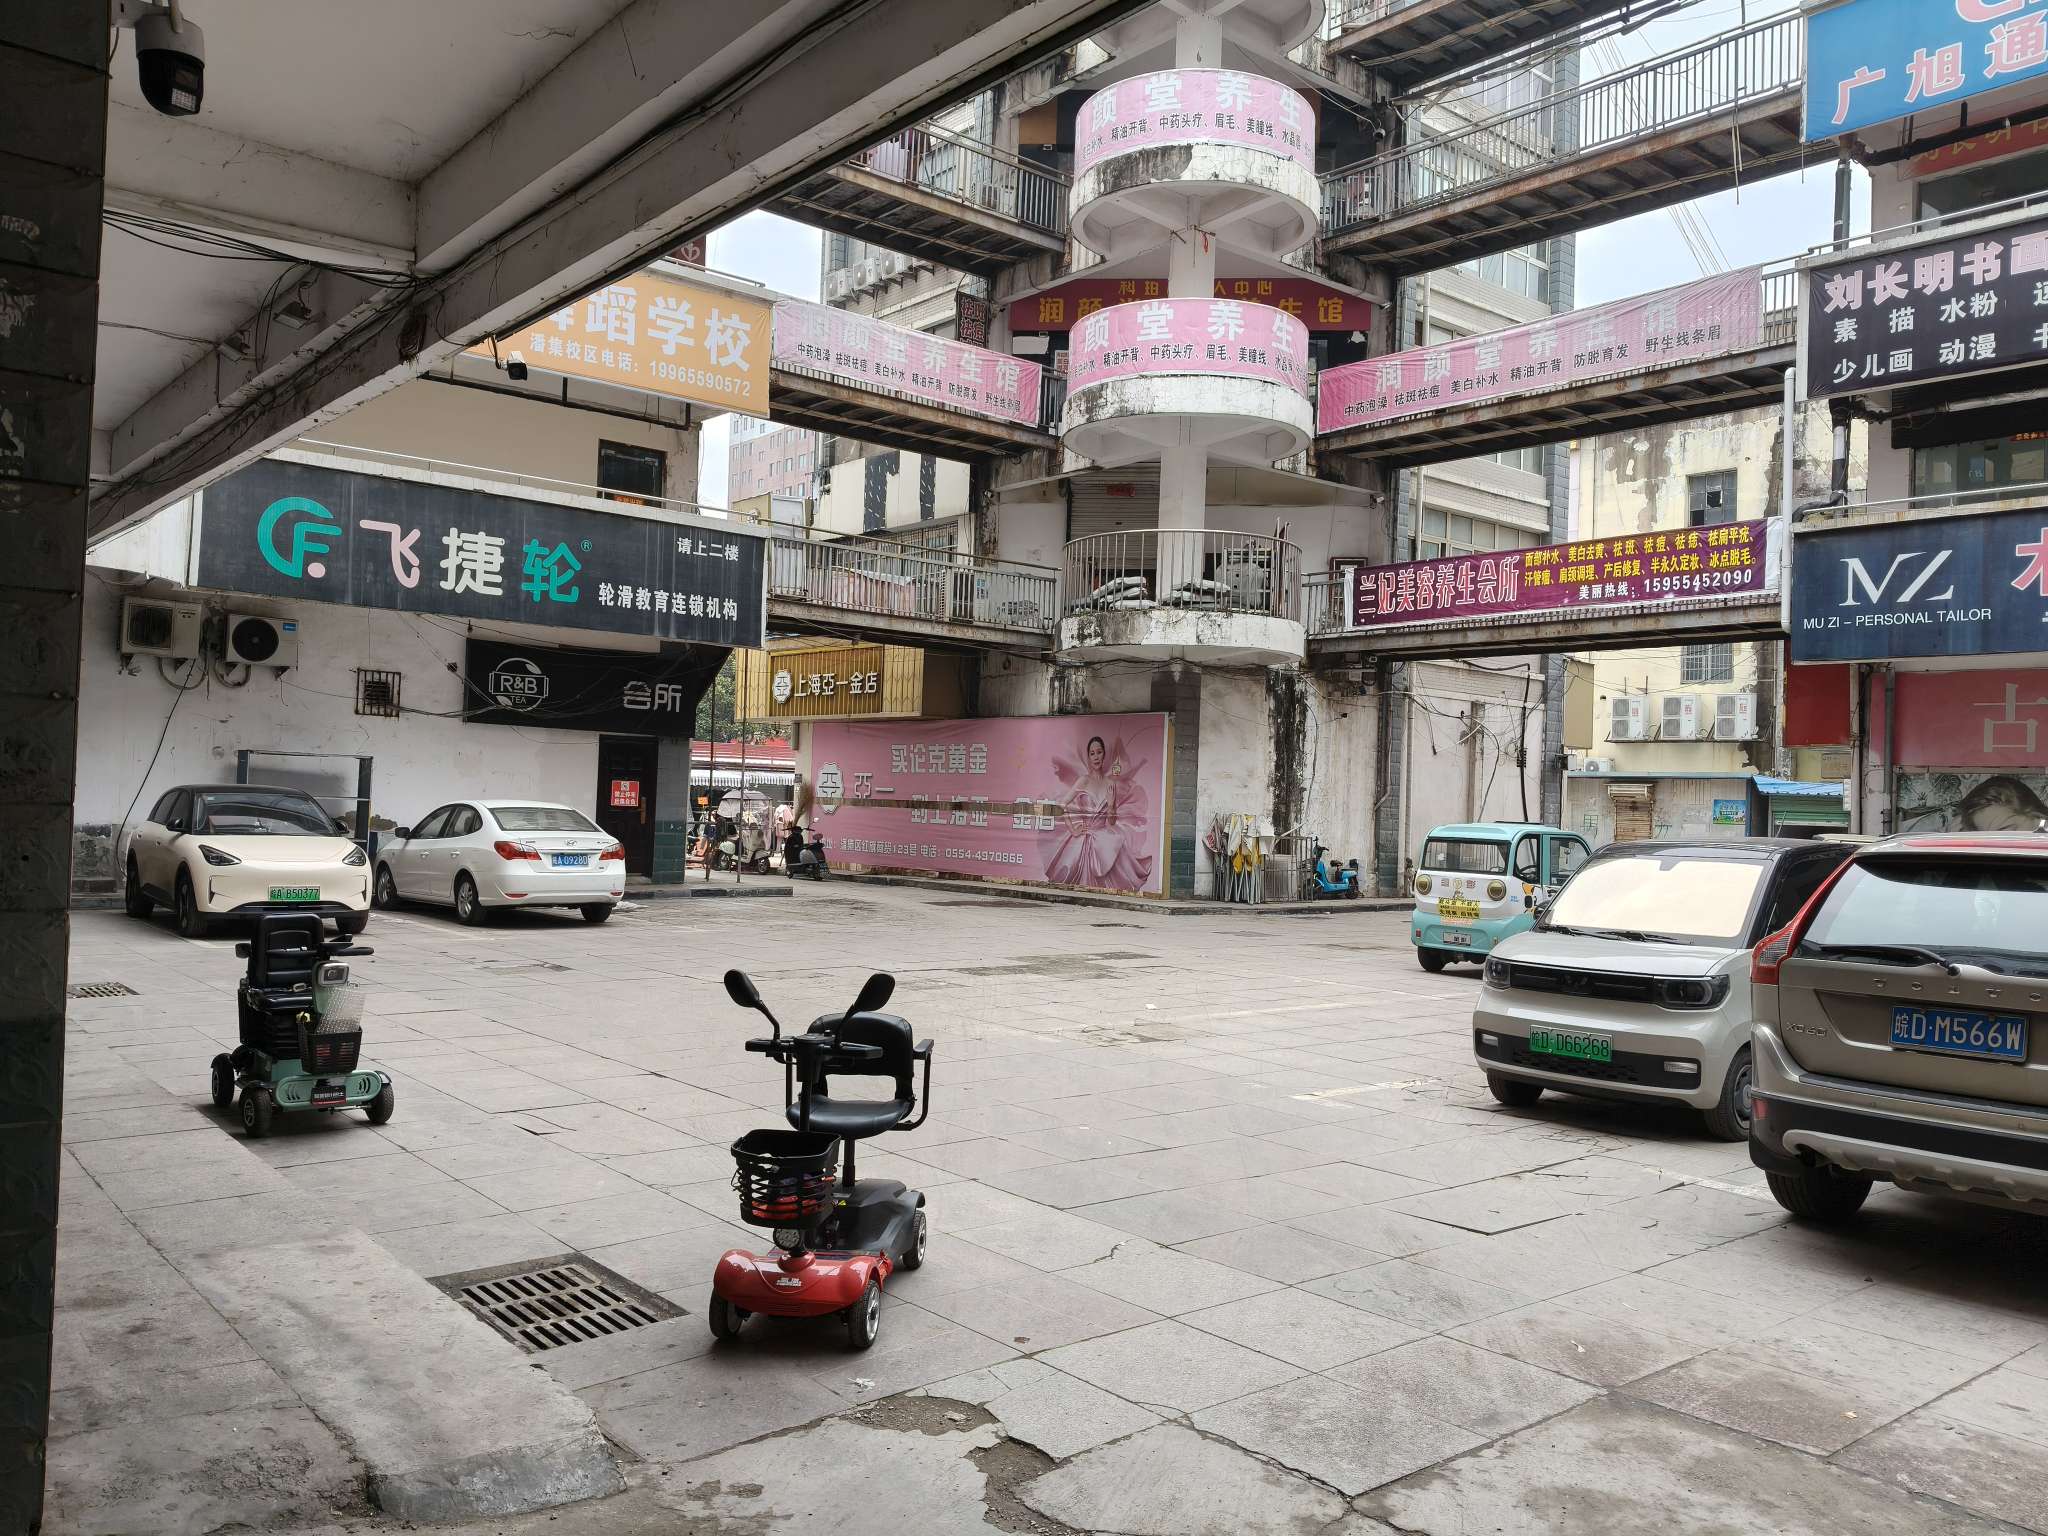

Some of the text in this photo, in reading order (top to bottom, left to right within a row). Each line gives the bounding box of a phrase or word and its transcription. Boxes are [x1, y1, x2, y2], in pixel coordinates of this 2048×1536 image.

[1940, 290, 1998, 323] 水粉
[1344, 325, 1721, 416] 中药泡澡 祛斑祛痘 美白补水 精油开背 防脱育发 野生线条眉
[1833, 348, 1913, 384] 少儿画
[1939, 333, 1996, 365] 动漫
[874, 363, 905, 381] 美白补水
[912, 373, 942, 391] 精油开背
[677, 538, 739, 562] 请上二楼
[1644, 569, 1753, 593] 15955452090
[1839, 550, 1954, 606] MZ
[598, 582, 738, 621] 轮滑教育连锁机构
[1804, 617, 1823, 629] MU
[1828, 616, 1840, 628] ZI
[1856, 613, 1933, 627] PERSONAL
[1937, 608, 1992, 623] TAILOR
[501, 675, 537, 694] R&B
[510, 695, 527, 705] TEA
